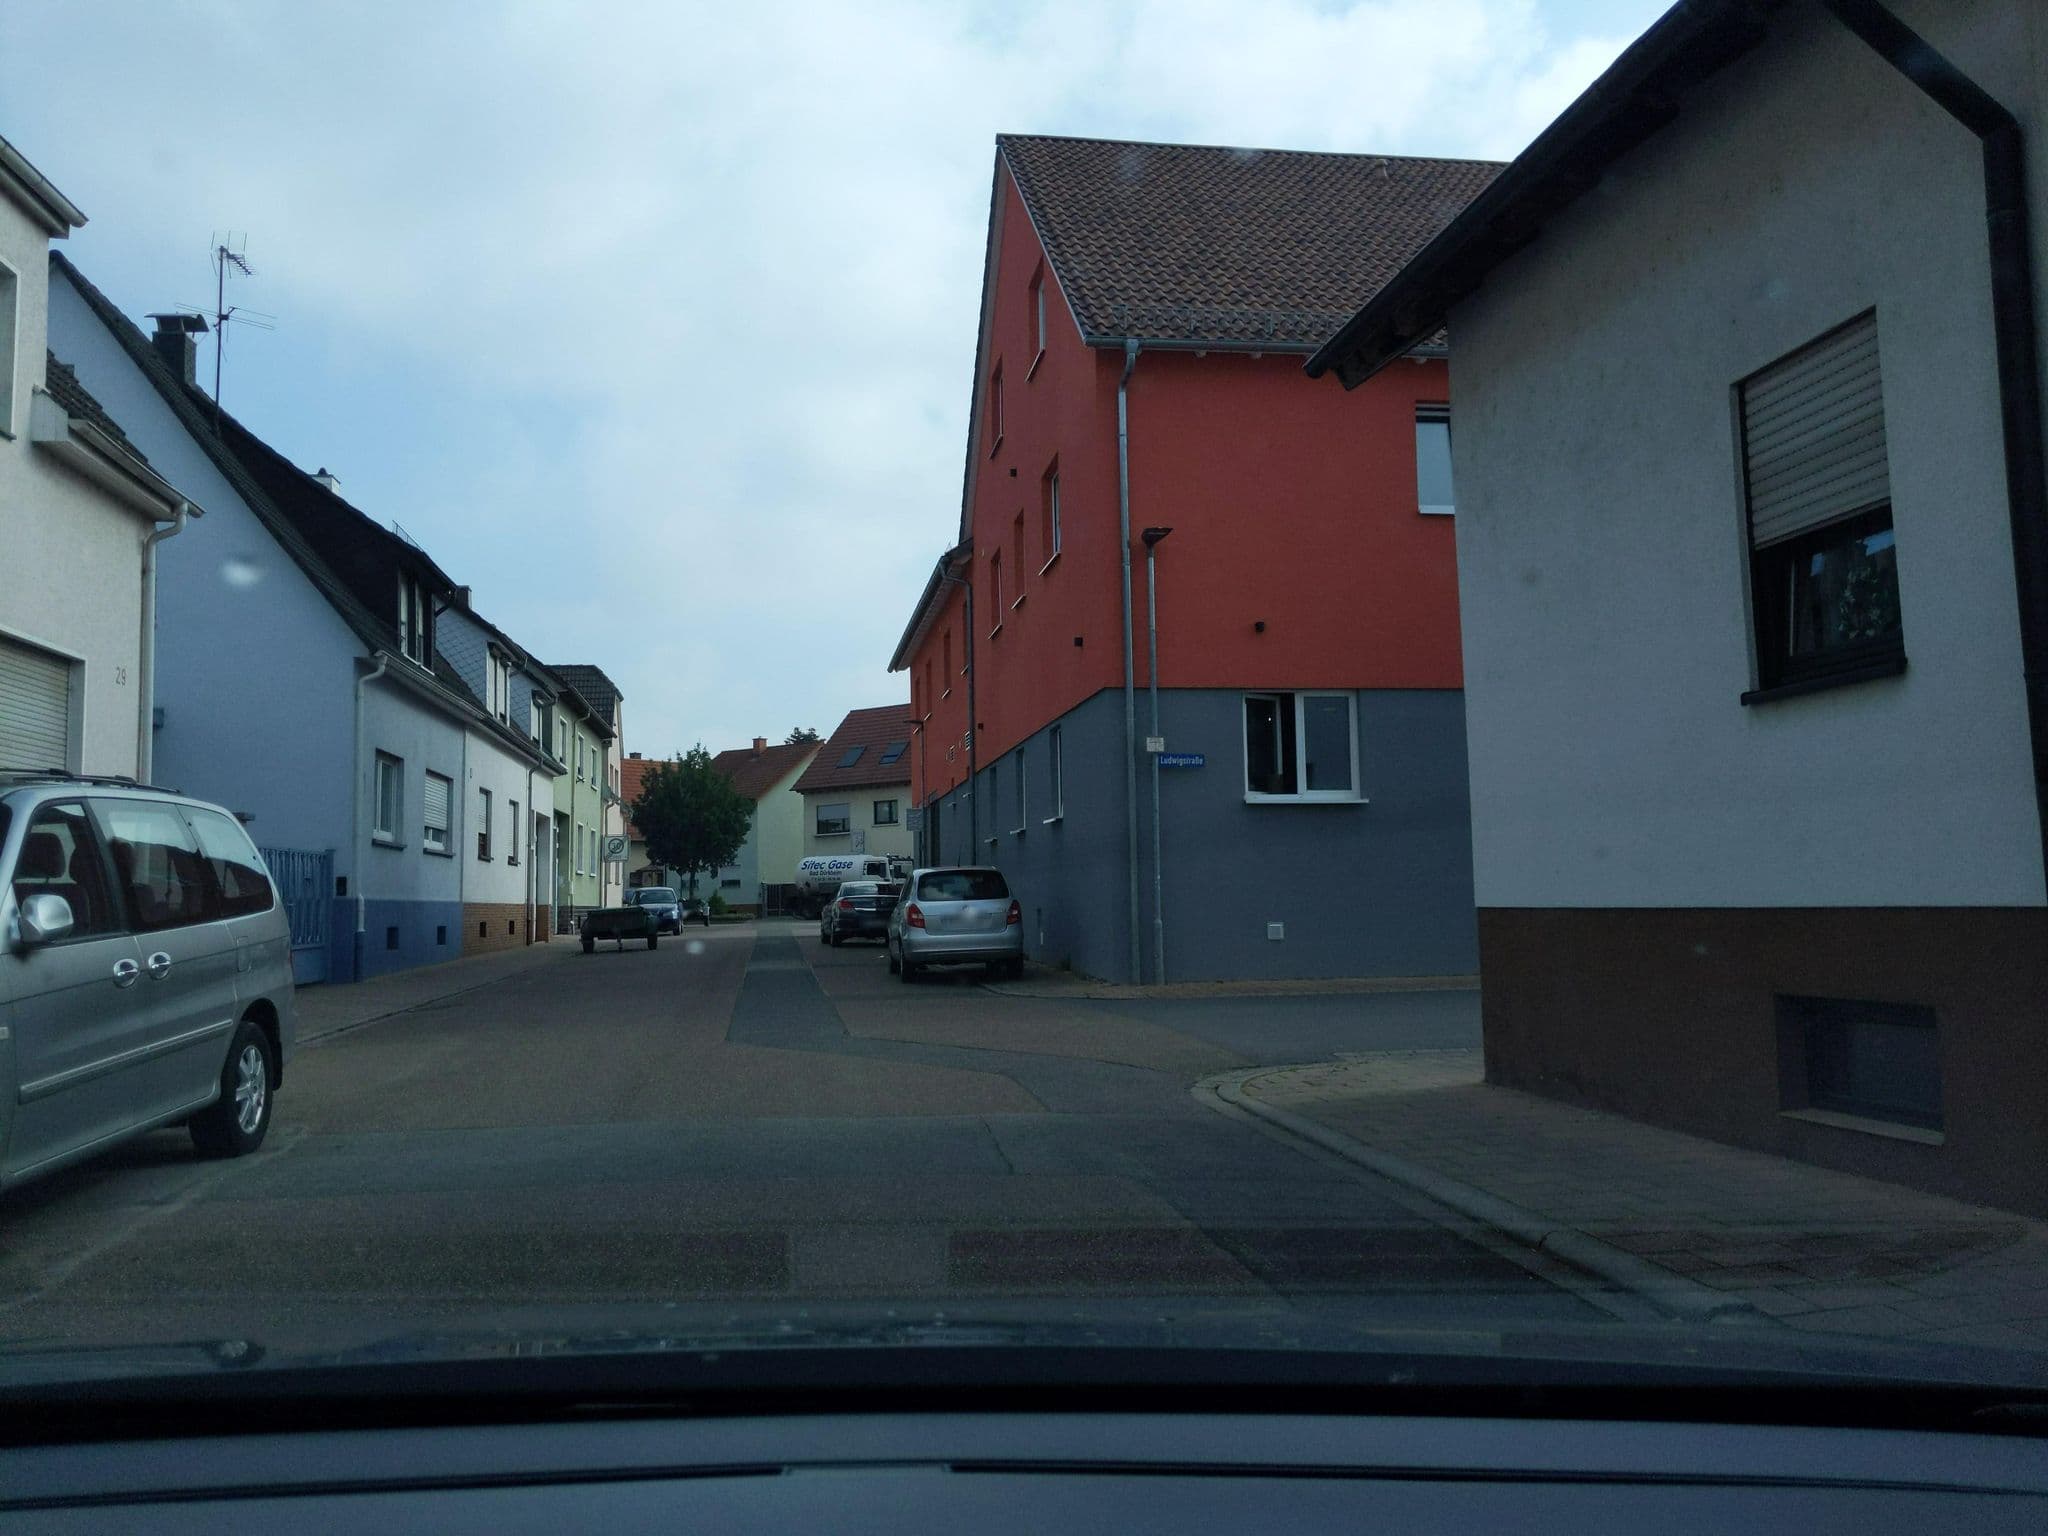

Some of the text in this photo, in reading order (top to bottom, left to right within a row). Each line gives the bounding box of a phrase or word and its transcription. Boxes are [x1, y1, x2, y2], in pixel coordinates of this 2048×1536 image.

[115, 666, 126, 686] 29
[1160, 755, 1203, 767] Ludwigstraße
[801, 860, 853, 870] Sitec Gase
